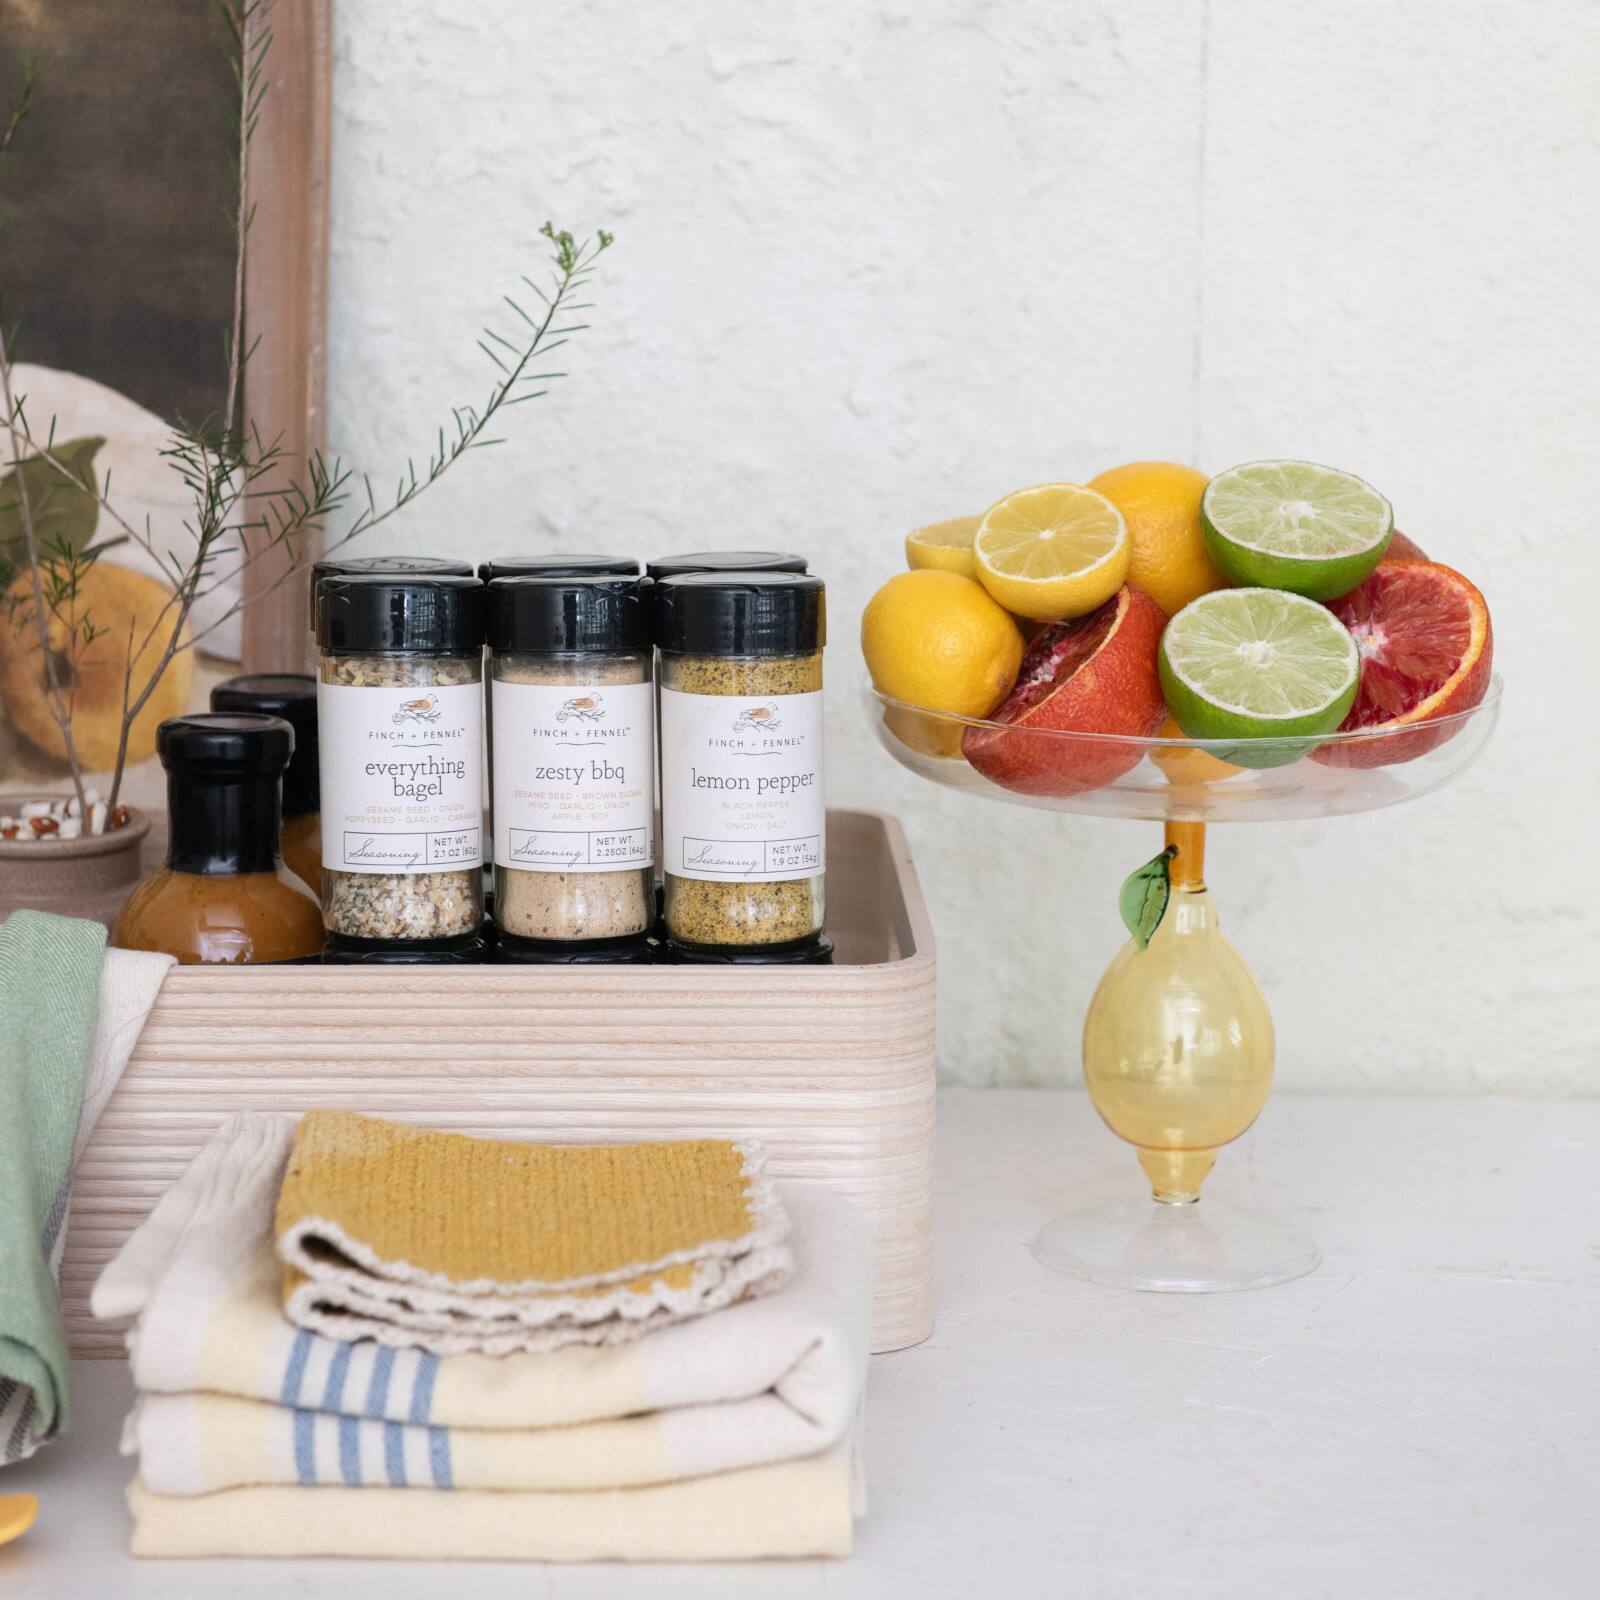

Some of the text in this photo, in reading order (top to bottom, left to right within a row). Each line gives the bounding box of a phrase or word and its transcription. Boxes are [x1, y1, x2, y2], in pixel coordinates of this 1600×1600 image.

[369, 731, 404, 740] FINCH
[533, 729, 568, 738] FINCH
[709, 738, 744, 748] FINCH
[365, 755, 465, 781] everything
[535, 760, 626, 786] zesty bbq
[691, 767, 815, 795] lemon pepper
[392, 776, 443, 802] bagel
[514, 789, 545, 799] SESAME
[548, 791, 572, 800] SEED
[582, 791, 617, 800] BROWN
[366, 805, 403, 814] SESAME
[406, 805, 430, 814] SEED
[438, 804, 464, 813] ONION
[528, 801, 549, 809] MISO
[560, 801, 595, 810] GARLIC
[604, 801, 631, 809] ONION
[721, 800, 791, 810] BLACK PEPPER
[344, 814, 396, 824] POPPYSEED
[406, 815, 440, 824] GARLIC
[552, 812, 581, 821] APPLE
[591, 812, 609, 821] SOY
[740, 811, 773, 820] LEMON
[726, 821, 757, 830] ONION
[766, 820, 787, 830] SALT
[434, 838, 453, 847] NET
[597, 837, 616, 846] NET
[347, 837, 422, 869] Seasoning
[434, 849, 446, 858] 2.1
[448, 848, 460, 857] OZ
[513, 835, 585, 867] Seasoning
[772, 845, 791, 855] NET
[687, 844, 760, 877] Seasoning
[772, 857, 785, 866] 1.9
[787, 855, 800, 865] OZ
